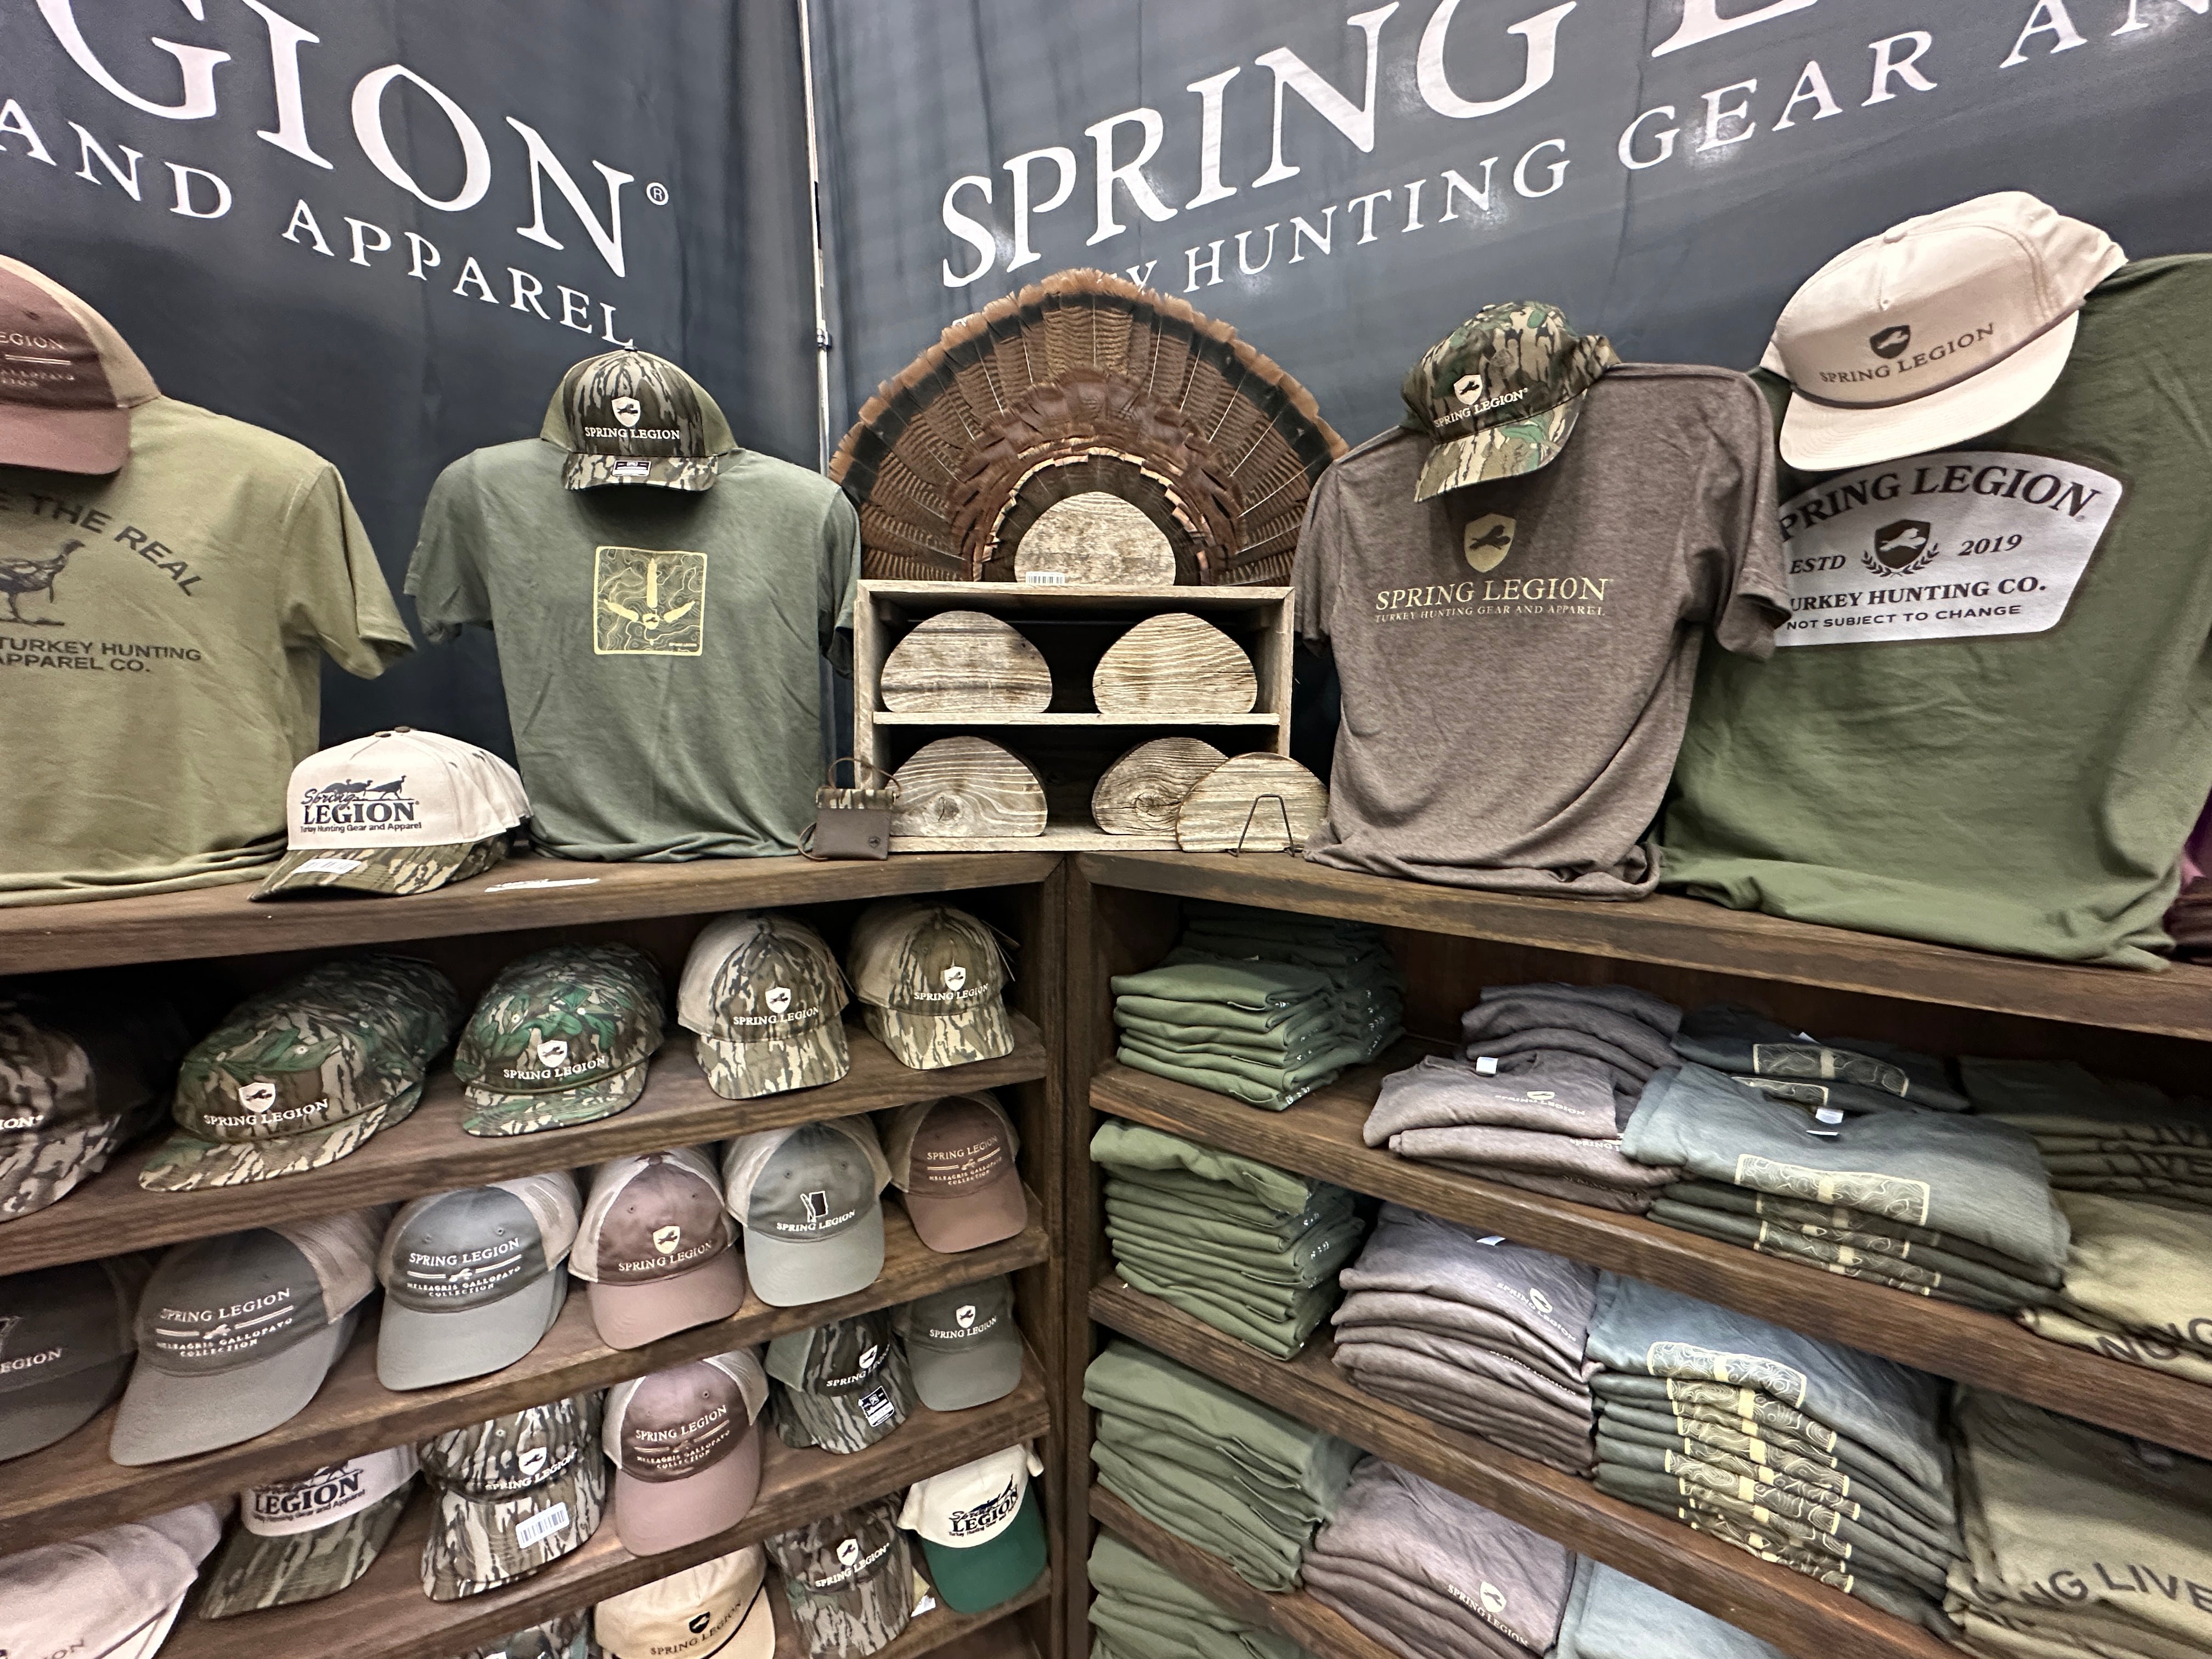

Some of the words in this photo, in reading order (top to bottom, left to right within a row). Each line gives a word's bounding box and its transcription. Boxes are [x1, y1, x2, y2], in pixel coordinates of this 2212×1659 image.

[942, 1, 1577, 289] SPRING
[1184, 138, 1571, 294] HUNTING
[1618, 30, 1937, 170] GEAR
[0, 98, 233, 218] AND
[283, 199, 635, 348] APPAREL
[1820, 364, 1891, 383] SPRING
[1897, 323, 1995, 373] LEGION
[1434, 408, 1471, 428] SPRING
[1474, 390, 1525, 414] LEGION
[585, 427, 628, 438] SPRING
[630, 429, 680, 439] LEGION
[1911, 465, 2102, 518] LEGION
[30, 493, 112, 534] THE
[114, 526, 202, 597] REAL
[1790, 555, 1846, 574] ESTD
[1958, 534, 2022, 556] 2019
[1376, 582, 1475, 610] SPRING
[1482, 577, 1609, 601] LEGION
[1867, 581, 1989, 605] HUNTING
[1997, 576, 2047, 592] CO.
[1375, 612, 1415, 623] TURKEY
[1421, 607, 1474, 619] HUNTING
[1477, 605, 1510, 615] GEAR
[1516, 605, 1543, 614] AND
[1787, 619, 1819, 630] NOT
[1823, 613, 1894, 628] SUBJECT
[1905, 611, 1928, 622] TO
[1936, 605, 2022, 620] CHANGE
[101, 642, 202, 661] HUNTING
[110, 658, 151, 673] CO.
[303, 802, 415, 825] LEGION
[318, 824, 345, 833] Hunting
[387, 822, 422, 832] Apparel
[914, 992, 953, 1001] SPRING
[956, 983, 989, 999] LEGION
[733, 1016, 776, 1025] SPRING
[779, 1007, 820, 1023] LEGION
[504, 1069, 551, 1080] SPRING
[555, 1056, 606, 1077] LEGION
[204, 1115, 256, 1126] SPRING
[261, 1099, 329, 1125] LEGION
[927, 1149, 964, 1161] SPRING
[776, 1222, 816, 1232] SPRING
[819, 1209, 856, 1229] LEGION
[409, 1252, 457, 1267] SPRING
[462, 1238, 521, 1263] LEGION
[618, 1257, 666, 1272] SPRING
[670, 1240, 713, 1264] LEGION
[218, 1288, 290, 1319] LEGION
[428, 1283, 494, 1297] COLLECTION
[929, 1329, 966, 1339] SPRING
[967, 1315, 997, 1336] LEGION
[180, 1339, 258, 1357] COLLECTION
[826, 1370, 867, 1387] SPRING
[635, 1429, 677, 1442] SPRING
[681, 1404, 727, 1436] LEGION
[485, 1477, 532, 1491] SPRING
[534, 1448, 577, 1483] LEGION
[255, 1473, 360, 1514] LEGION
[815, 1567, 851, 1587] SPRING
[853, 1545, 887, 1573] LEGION
[1448, 1584, 1486, 1617] SPRING
[1487, 1613, 1528, 1646] LEGION
[650, 1638, 698, 1655] SPRING
